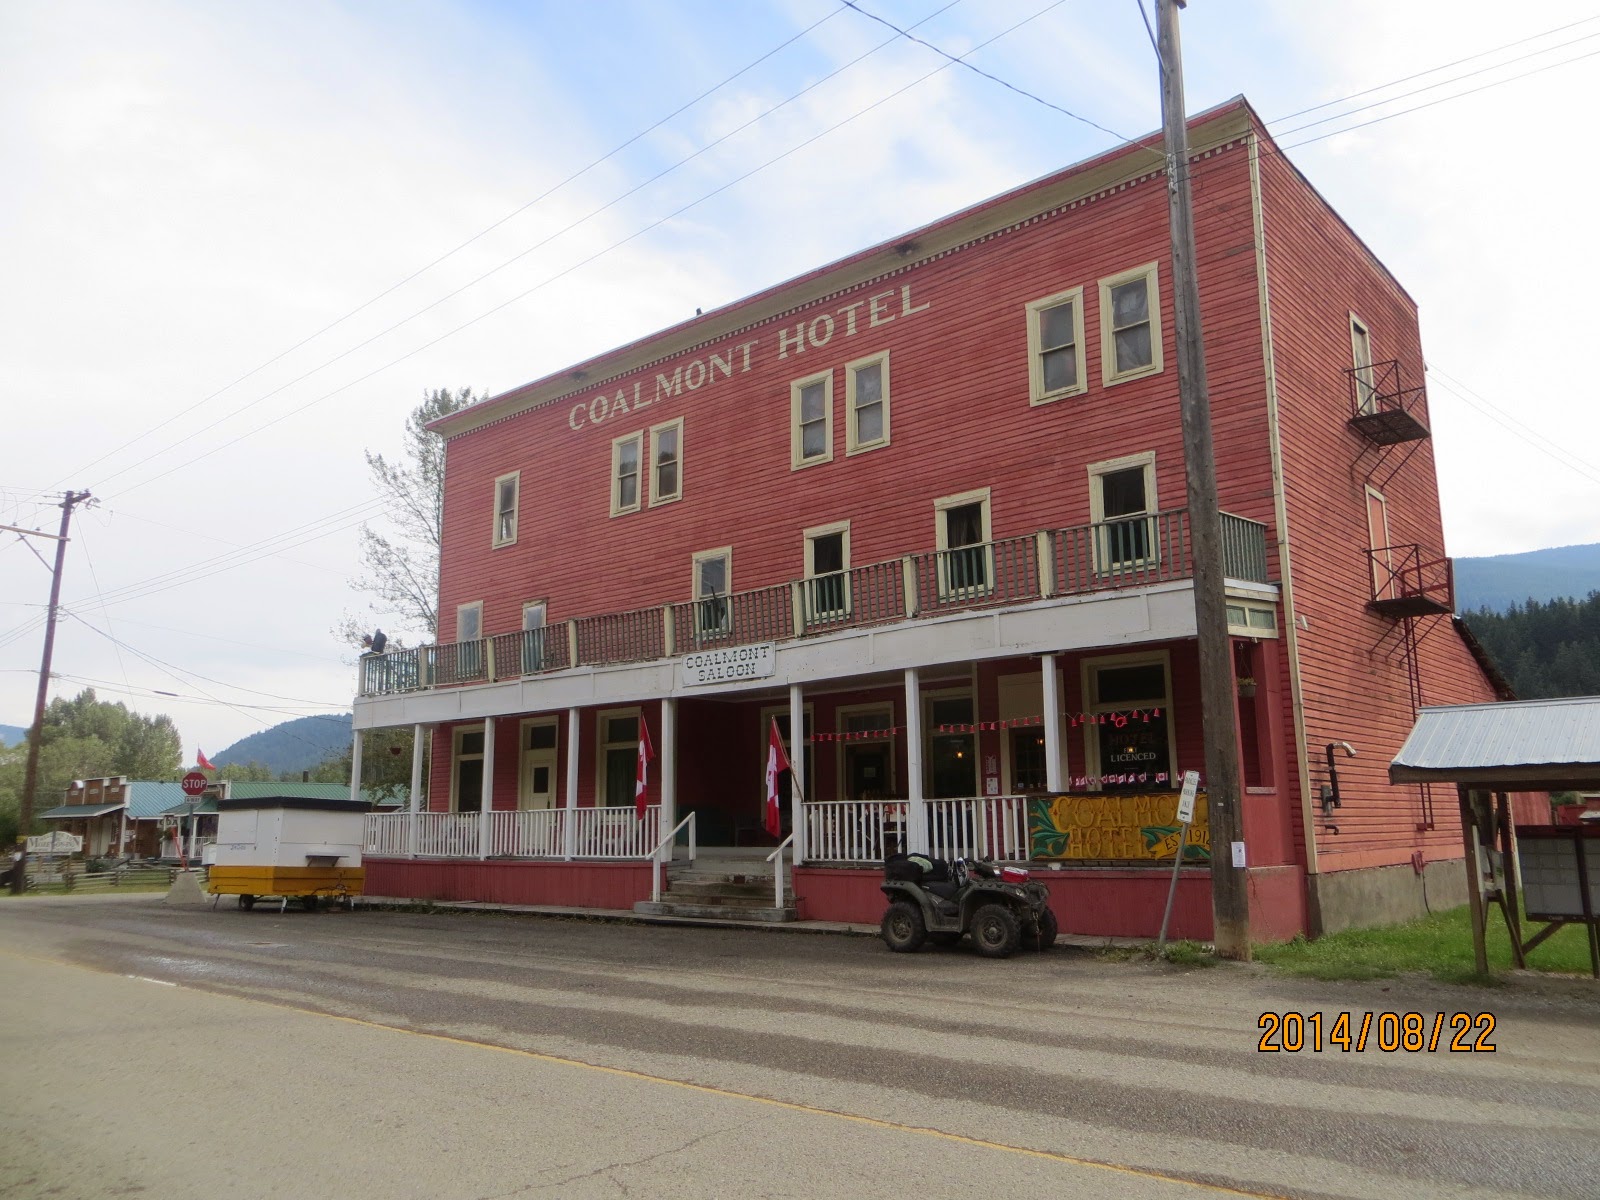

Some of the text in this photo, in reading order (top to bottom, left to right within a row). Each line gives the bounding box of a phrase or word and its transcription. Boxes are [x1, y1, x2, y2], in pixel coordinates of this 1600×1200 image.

[569, 284, 930, 431] COALMONT HOTEL
[686, 645, 770, 669] COALMONT
[698, 662, 756, 682] SALOON
[1110, 752, 1156, 762] LICENCED
[183, 779, 206, 789] STOP
[1068, 826, 1152, 857] HOTEL
